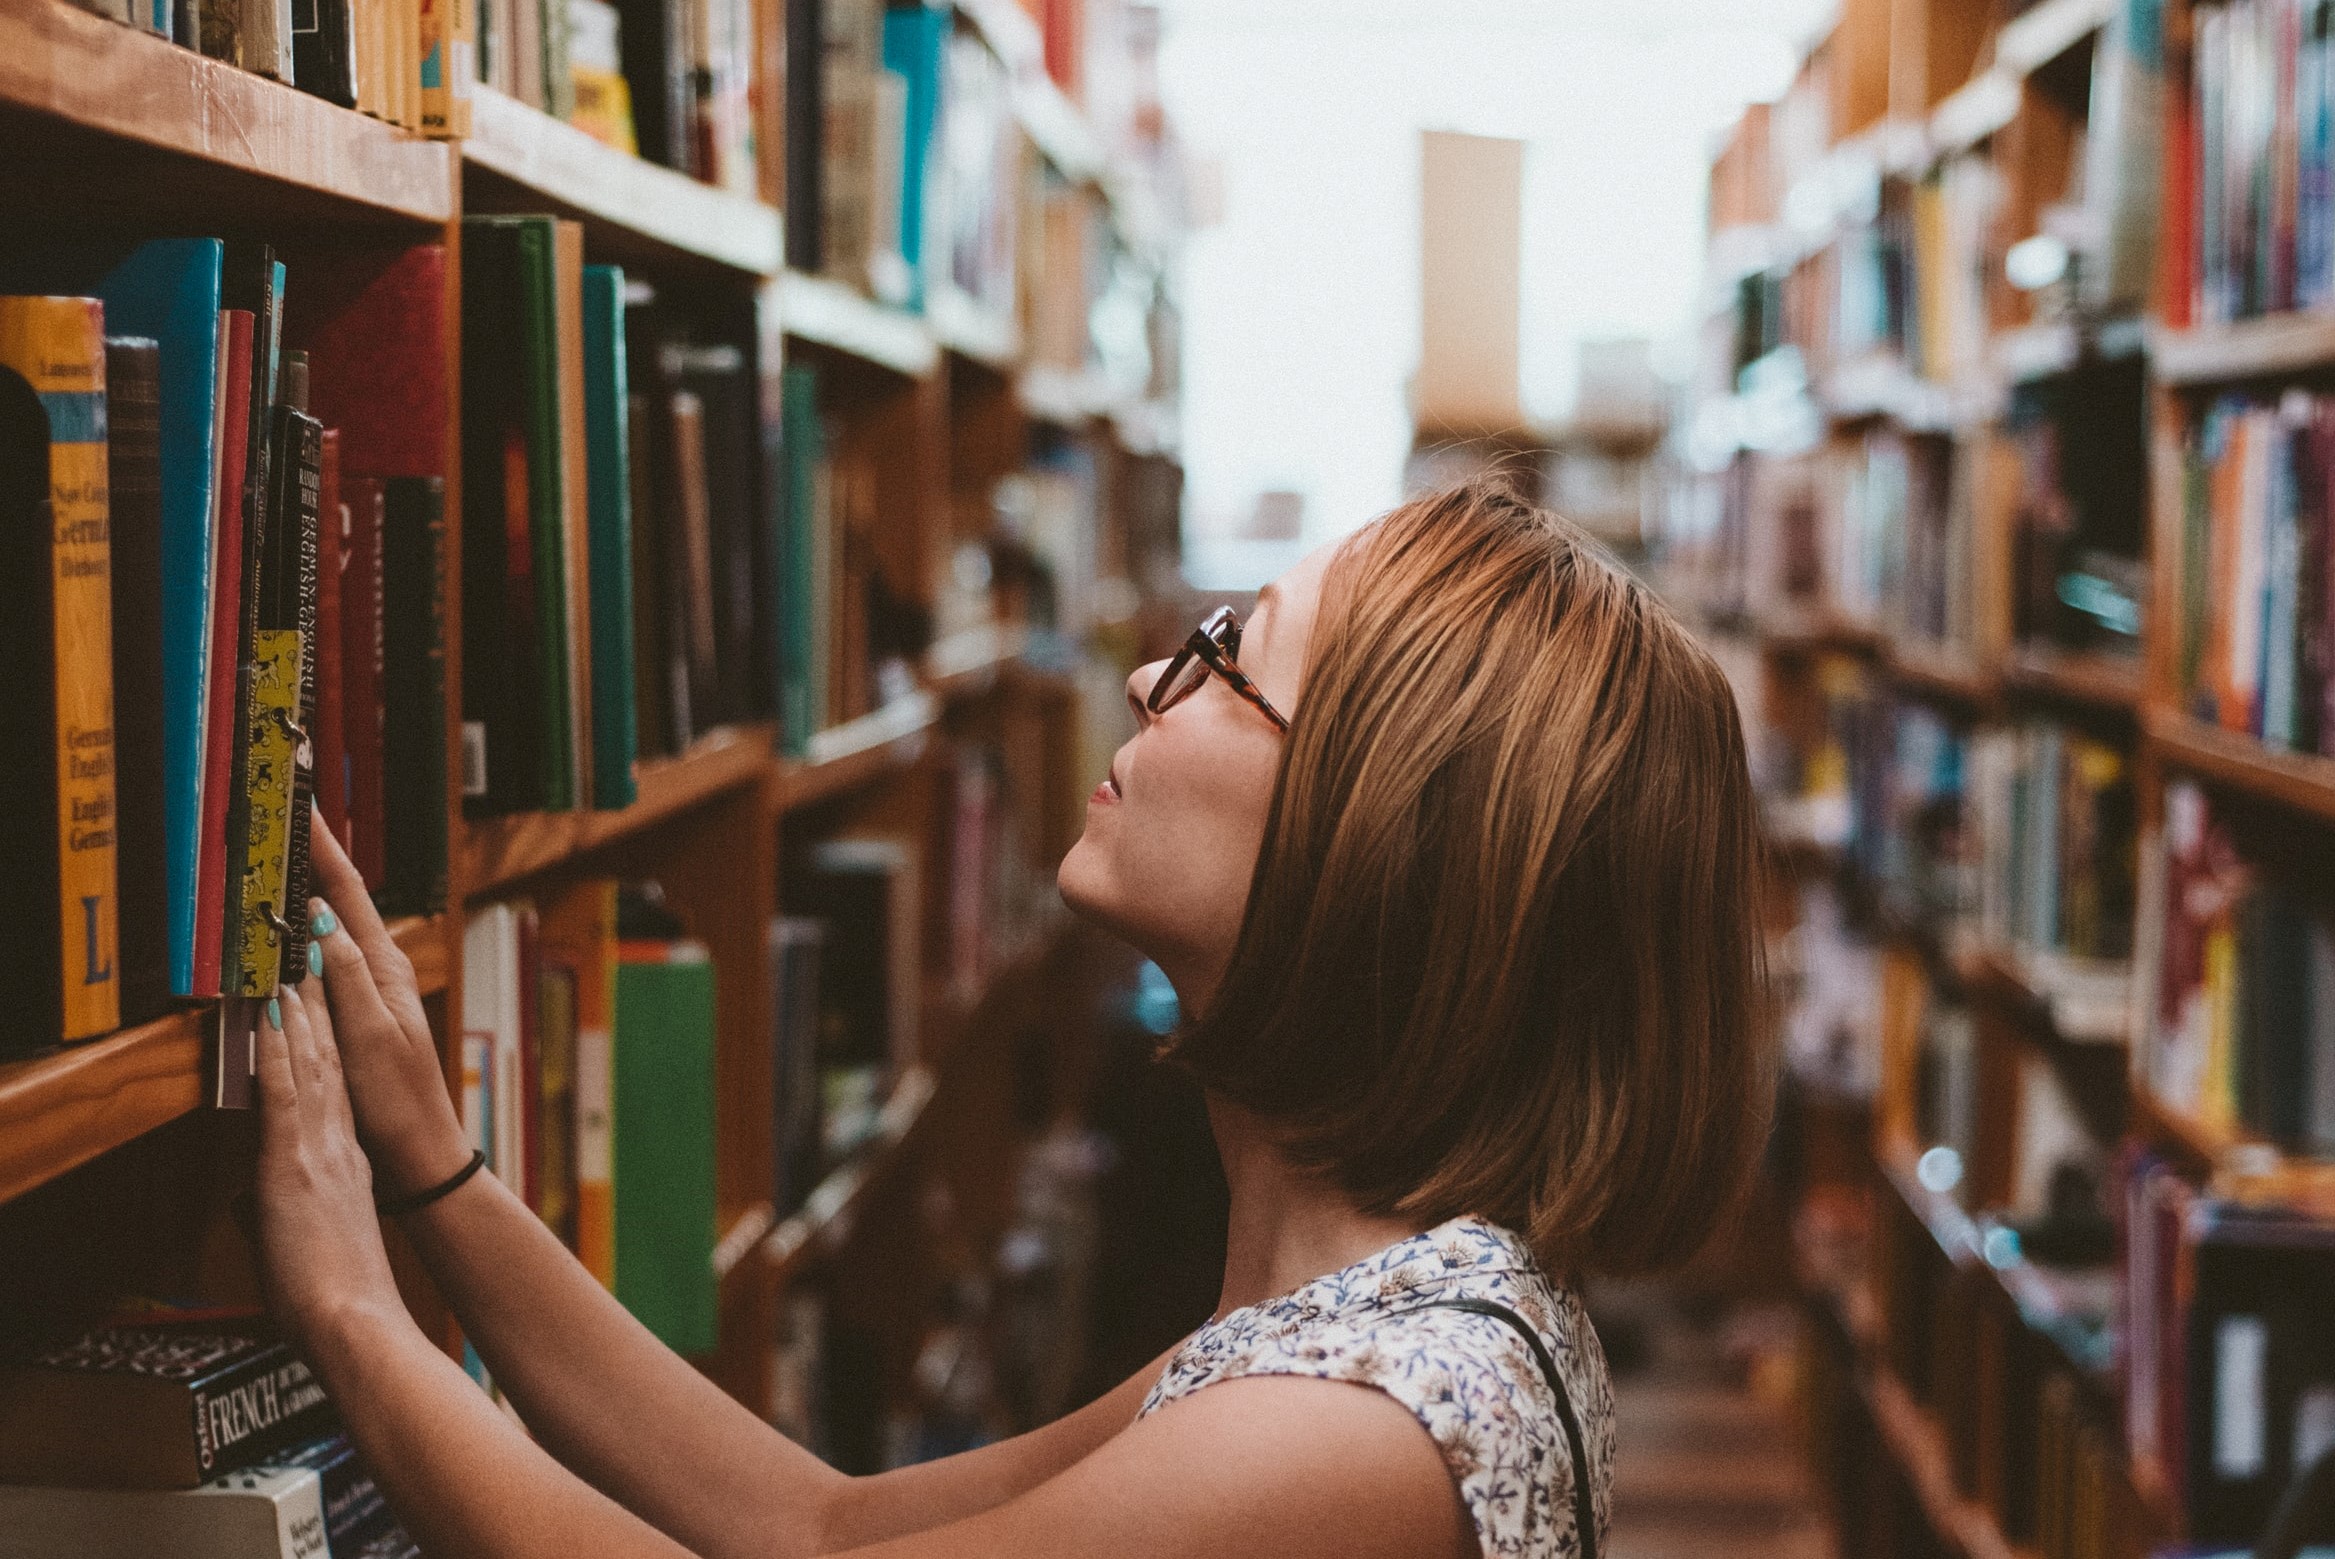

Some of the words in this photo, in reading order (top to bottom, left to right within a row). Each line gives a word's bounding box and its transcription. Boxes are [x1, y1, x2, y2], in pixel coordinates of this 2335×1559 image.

[306, 516, 317, 688] GERMAN-ENGLISH
[81, 896, 111, 985] L
[209, 1373, 280, 1450] FRENCH
